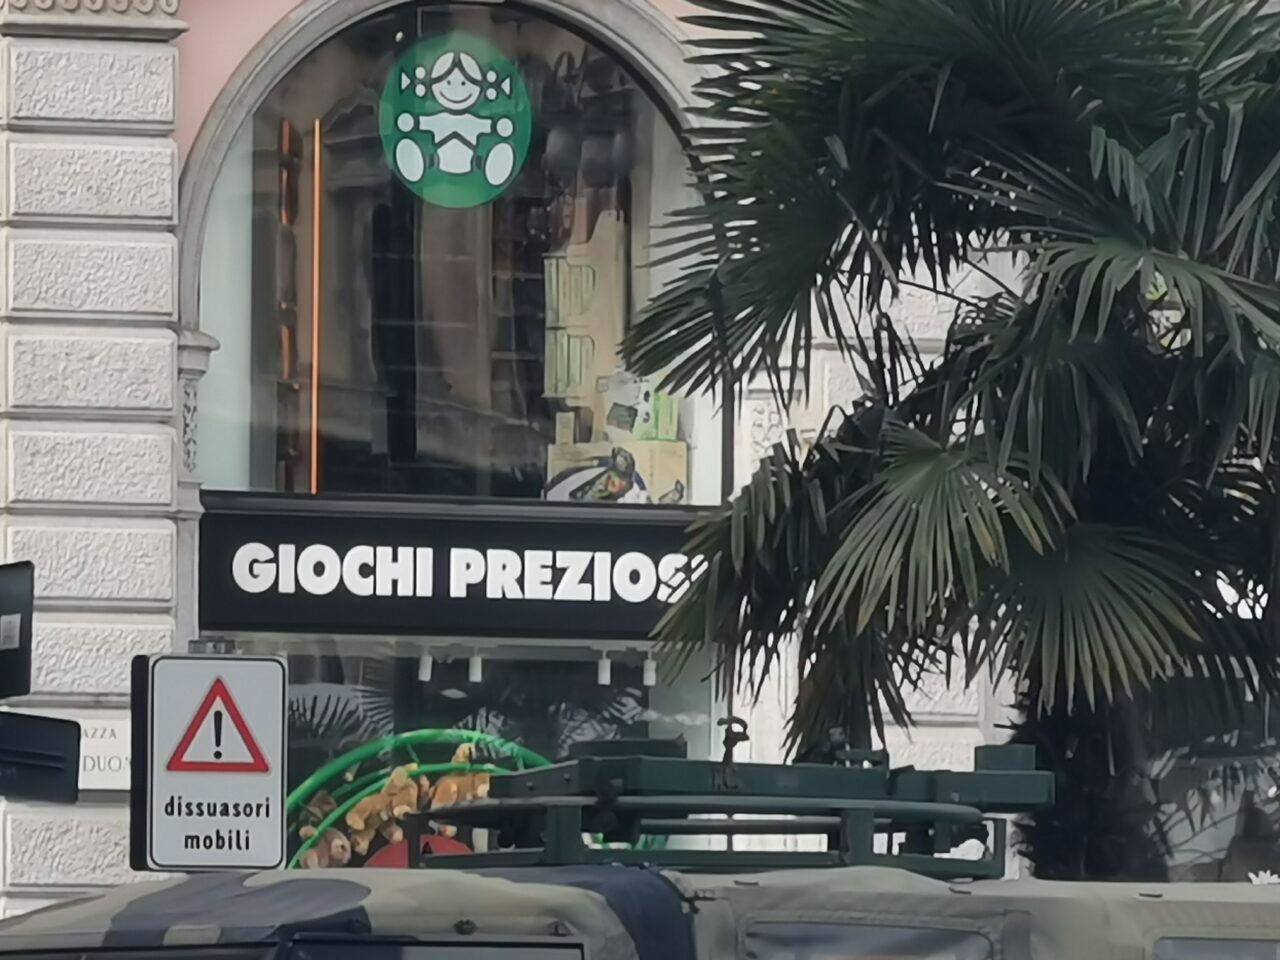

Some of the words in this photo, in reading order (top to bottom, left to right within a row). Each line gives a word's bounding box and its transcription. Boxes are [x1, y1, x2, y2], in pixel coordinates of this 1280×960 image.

[232, 542, 434, 597] GIOCHI
[450, 547, 709, 604] PREZIOS
[164, 795, 270, 818] dissuasori
[184, 829, 250, 851] mobili
